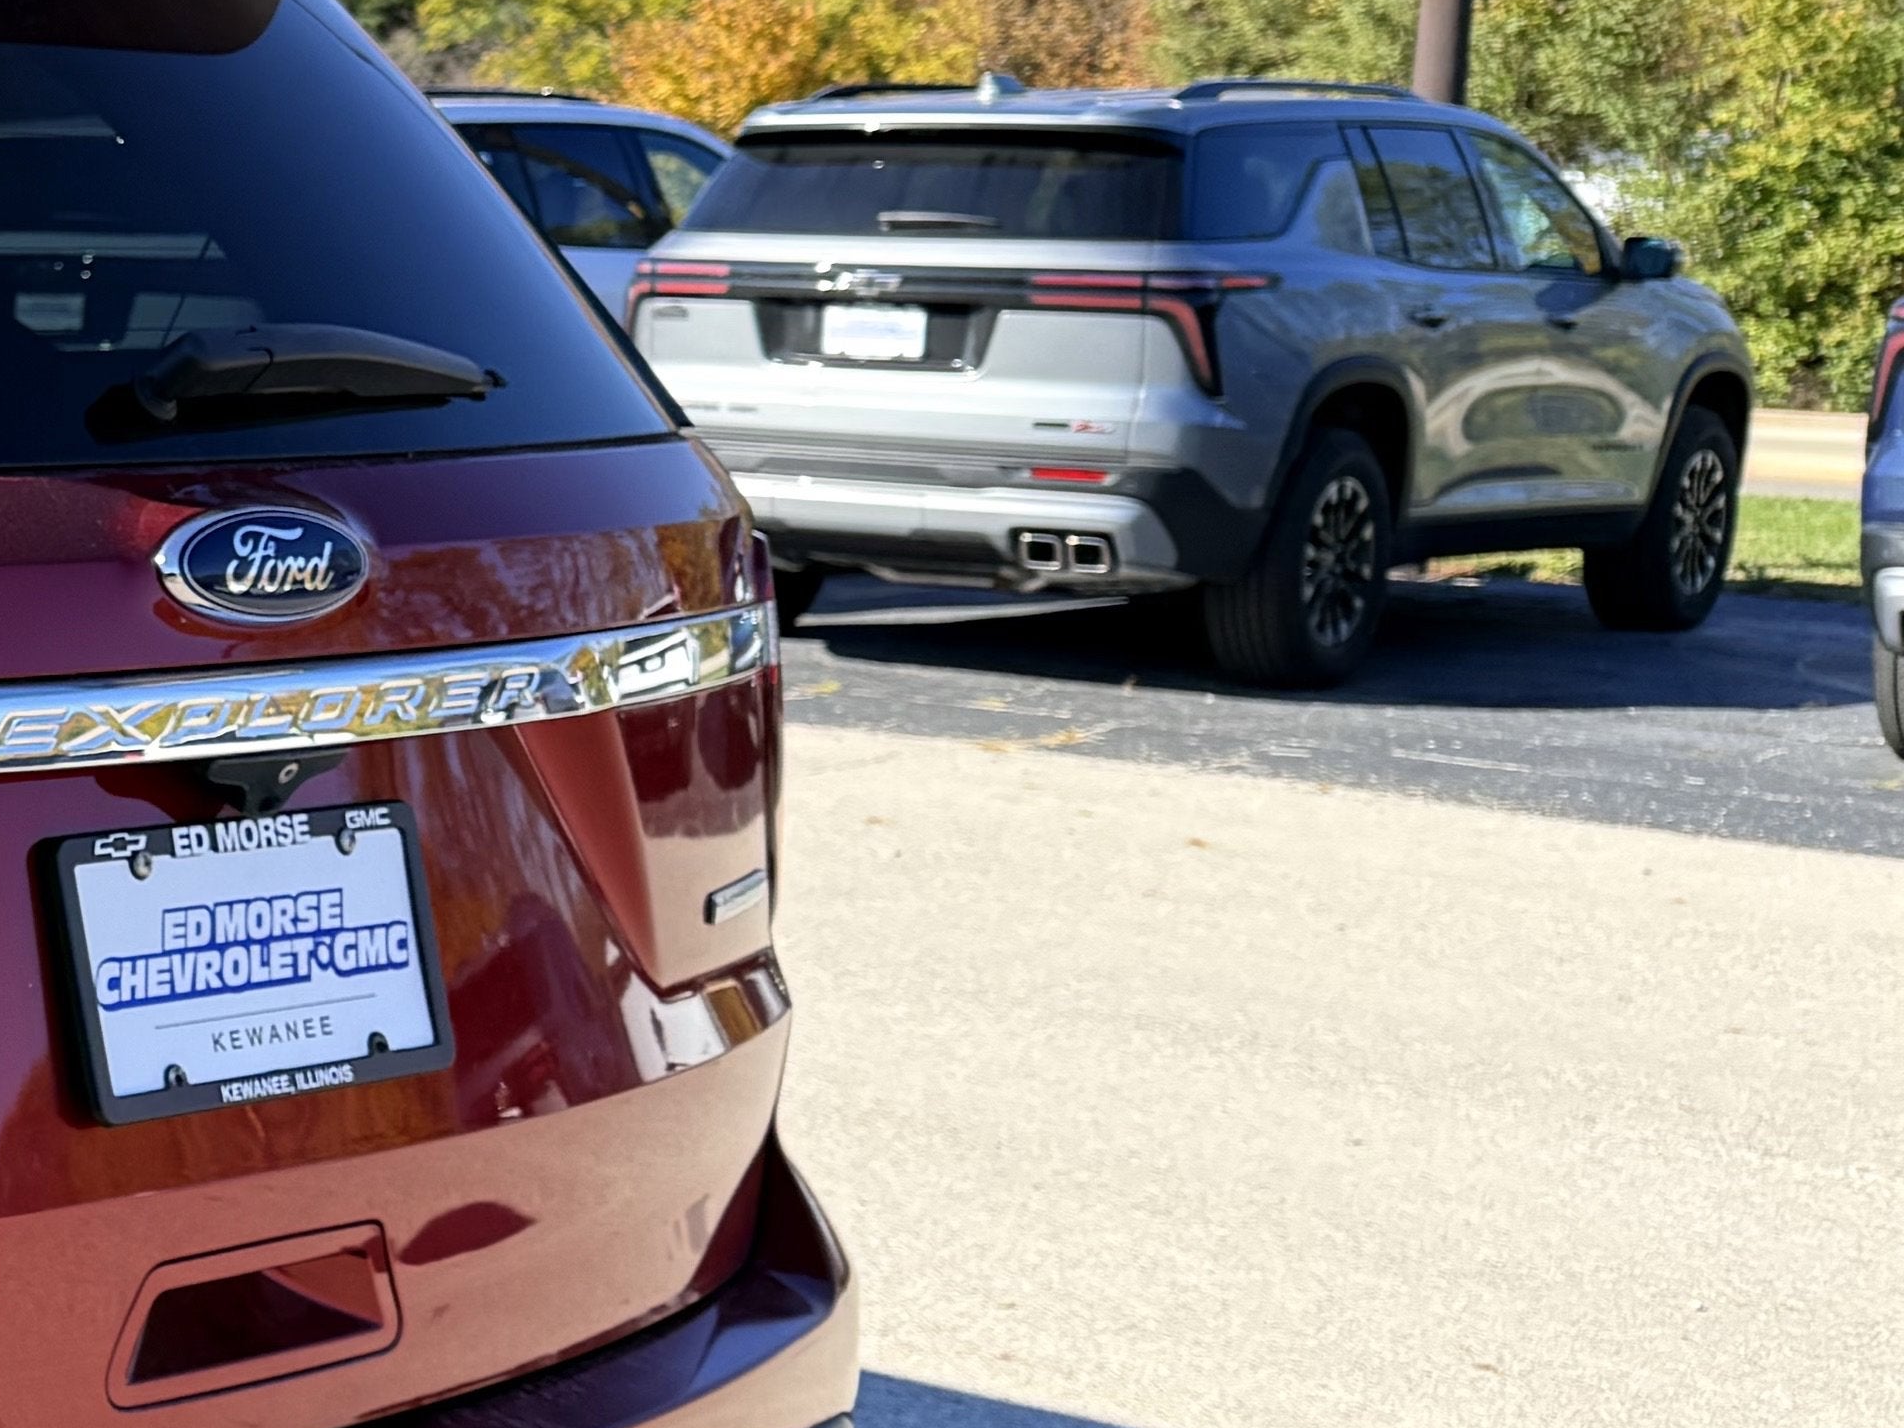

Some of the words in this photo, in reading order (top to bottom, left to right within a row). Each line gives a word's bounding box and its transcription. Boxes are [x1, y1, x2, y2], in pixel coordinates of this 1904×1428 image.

[225, 524, 336, 594] Ford
[171, 825, 211, 858] ED
[214, 813, 312, 854] MORSE
[344, 806, 392, 830] GMC
[162, 905, 213, 951] ED
[214, 888, 343, 945] MORSE
[211, 1015, 334, 1053] KEWANEE
[220, 1073, 296, 1104] KEWANEE,
[295, 1064, 355, 1091] ILLINOIS
